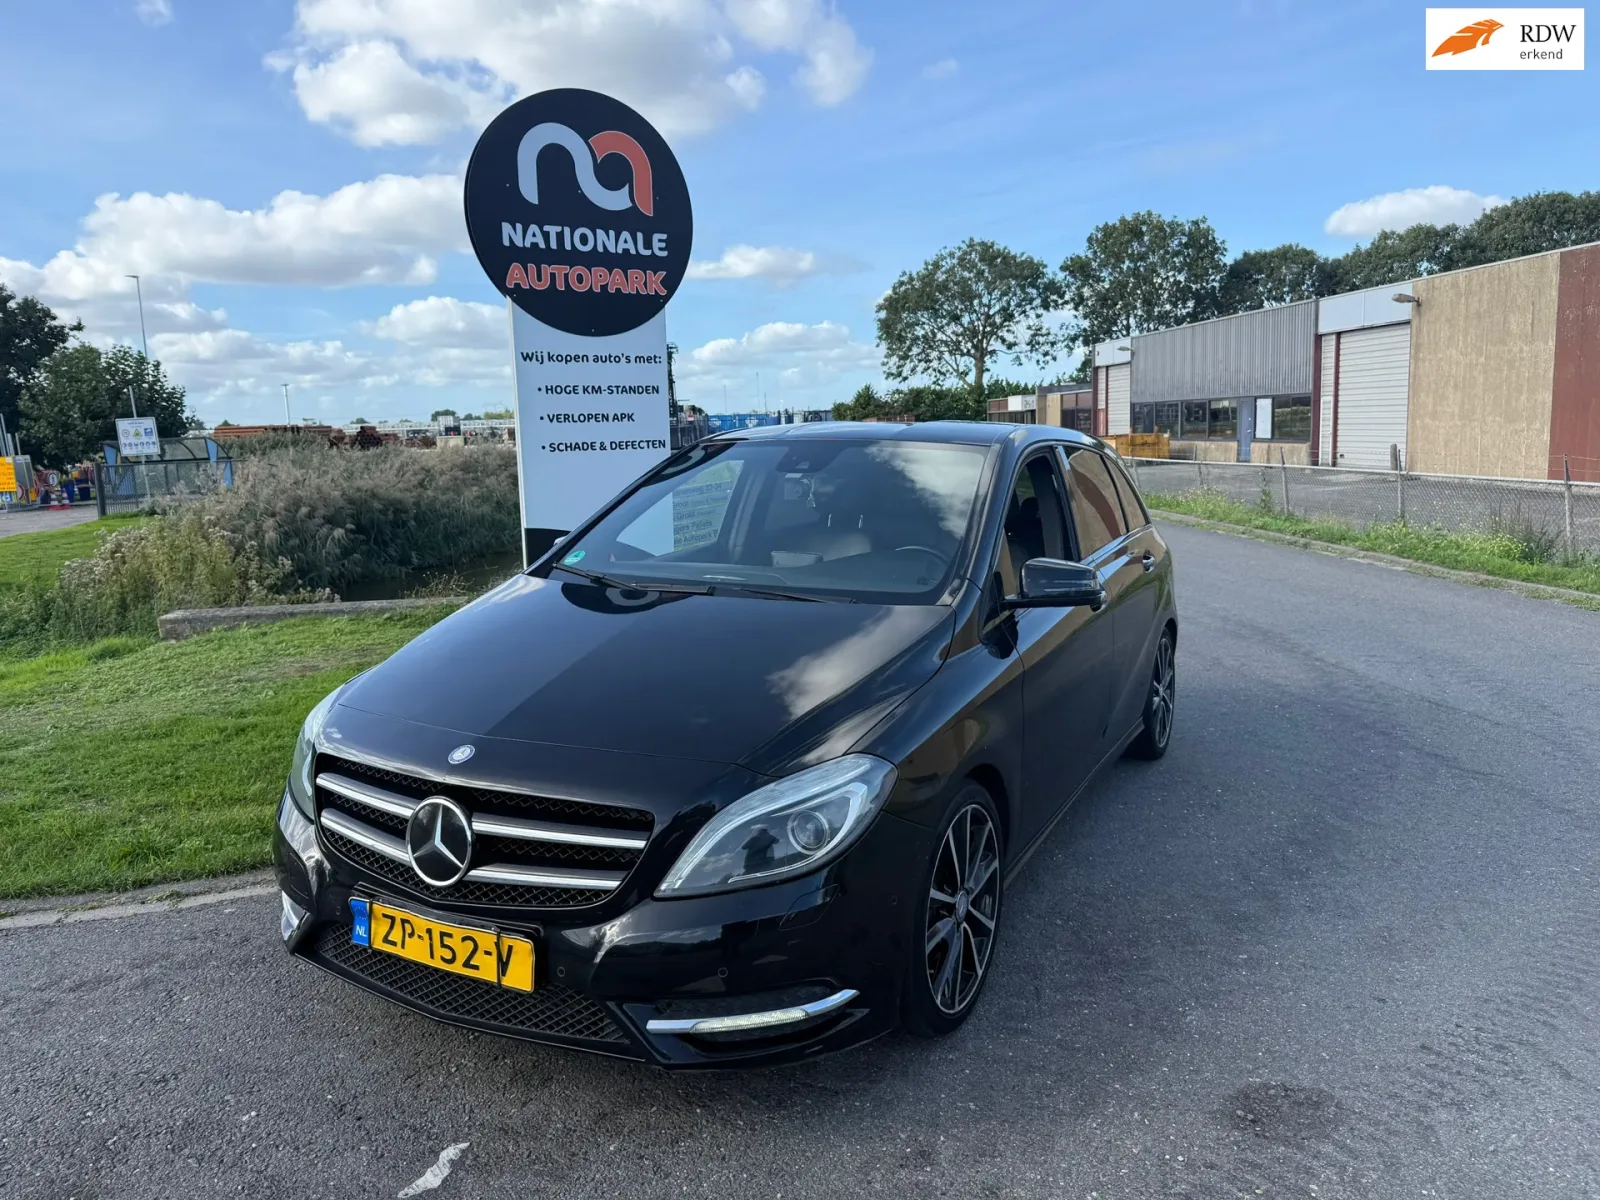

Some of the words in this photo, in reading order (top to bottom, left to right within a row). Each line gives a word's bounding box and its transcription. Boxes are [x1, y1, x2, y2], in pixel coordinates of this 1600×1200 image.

[501, 221, 668, 257] NATIONALE
[505, 262, 668, 296] AUTOPARK
[520, 350, 545, 365] Wij
[547, 351, 590, 365] kopen
[592, 352, 632, 364] auto's
[634, 354, 662, 364] met:
[545, 384, 580, 395] HOGE
[582, 384, 660, 395] KM-STANDEN
[546, 412, 610, 424] VERLOPEN
[611, 412, 636, 423] APK
[549, 441, 597, 453] SCHADE
[598, 442, 608, 452] &
[609, 439, 666, 452] DEFECTEN
[355, 924, 368, 938] NL
[381, 912, 514, 978] ZP-152-V
